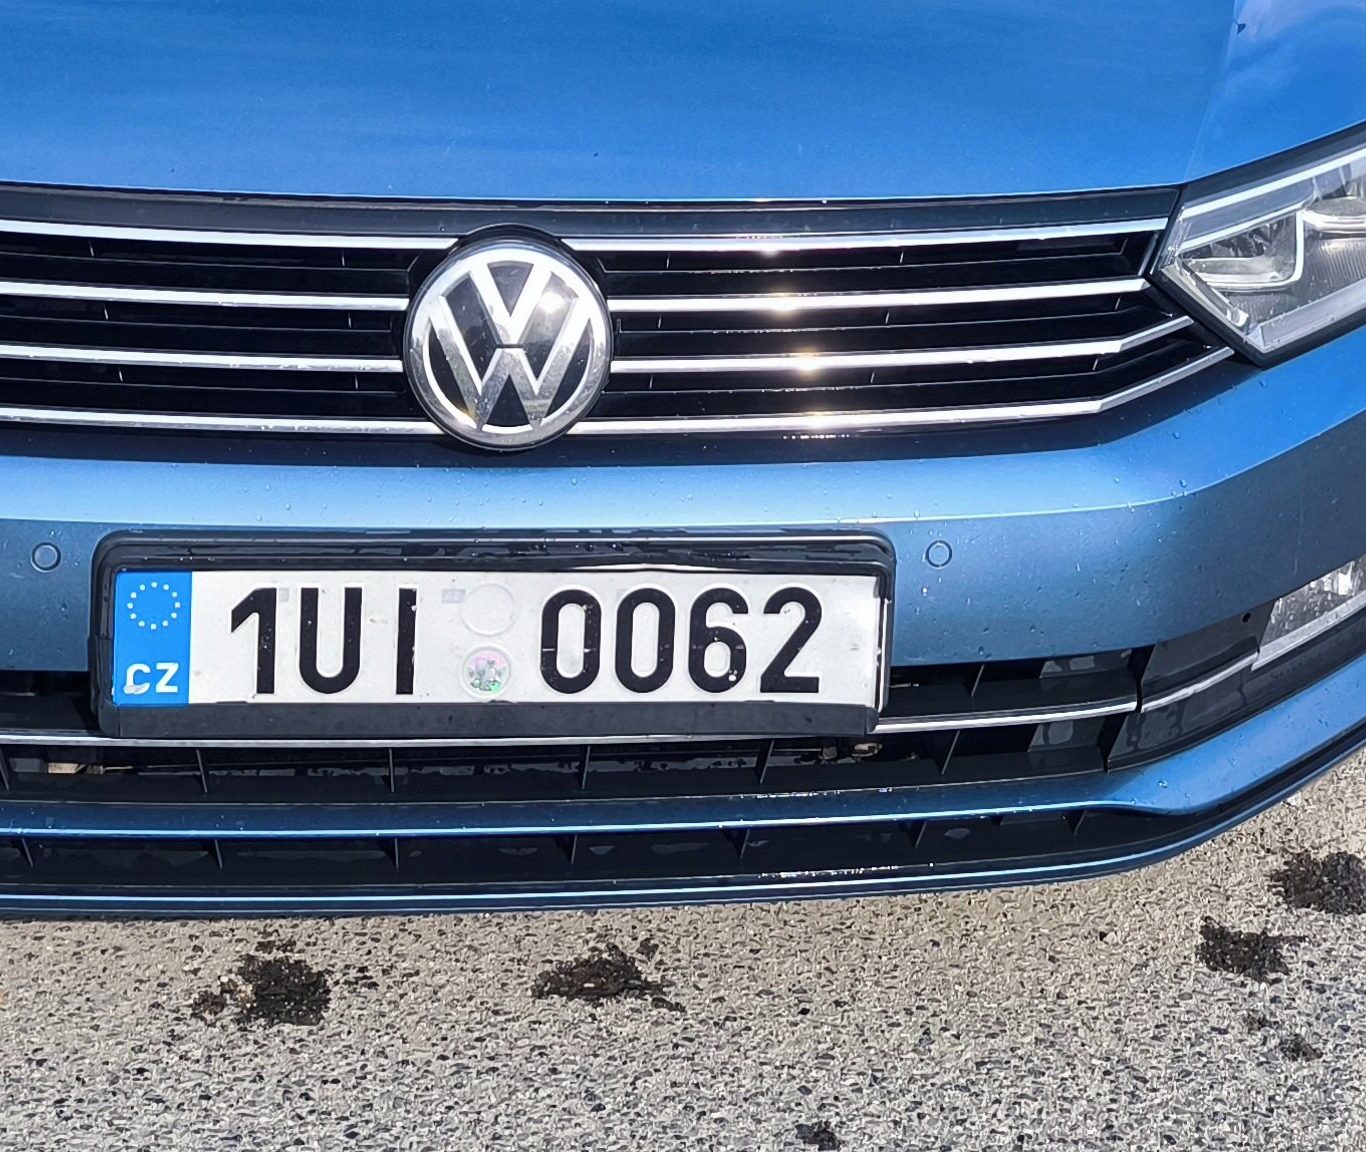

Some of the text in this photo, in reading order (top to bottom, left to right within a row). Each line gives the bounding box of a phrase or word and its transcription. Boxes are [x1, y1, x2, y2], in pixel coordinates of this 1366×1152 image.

[415, 249, 604, 441] VW
[123, 662, 179, 695] CZ
[230, 586, 823, 695] 1UI 0062
